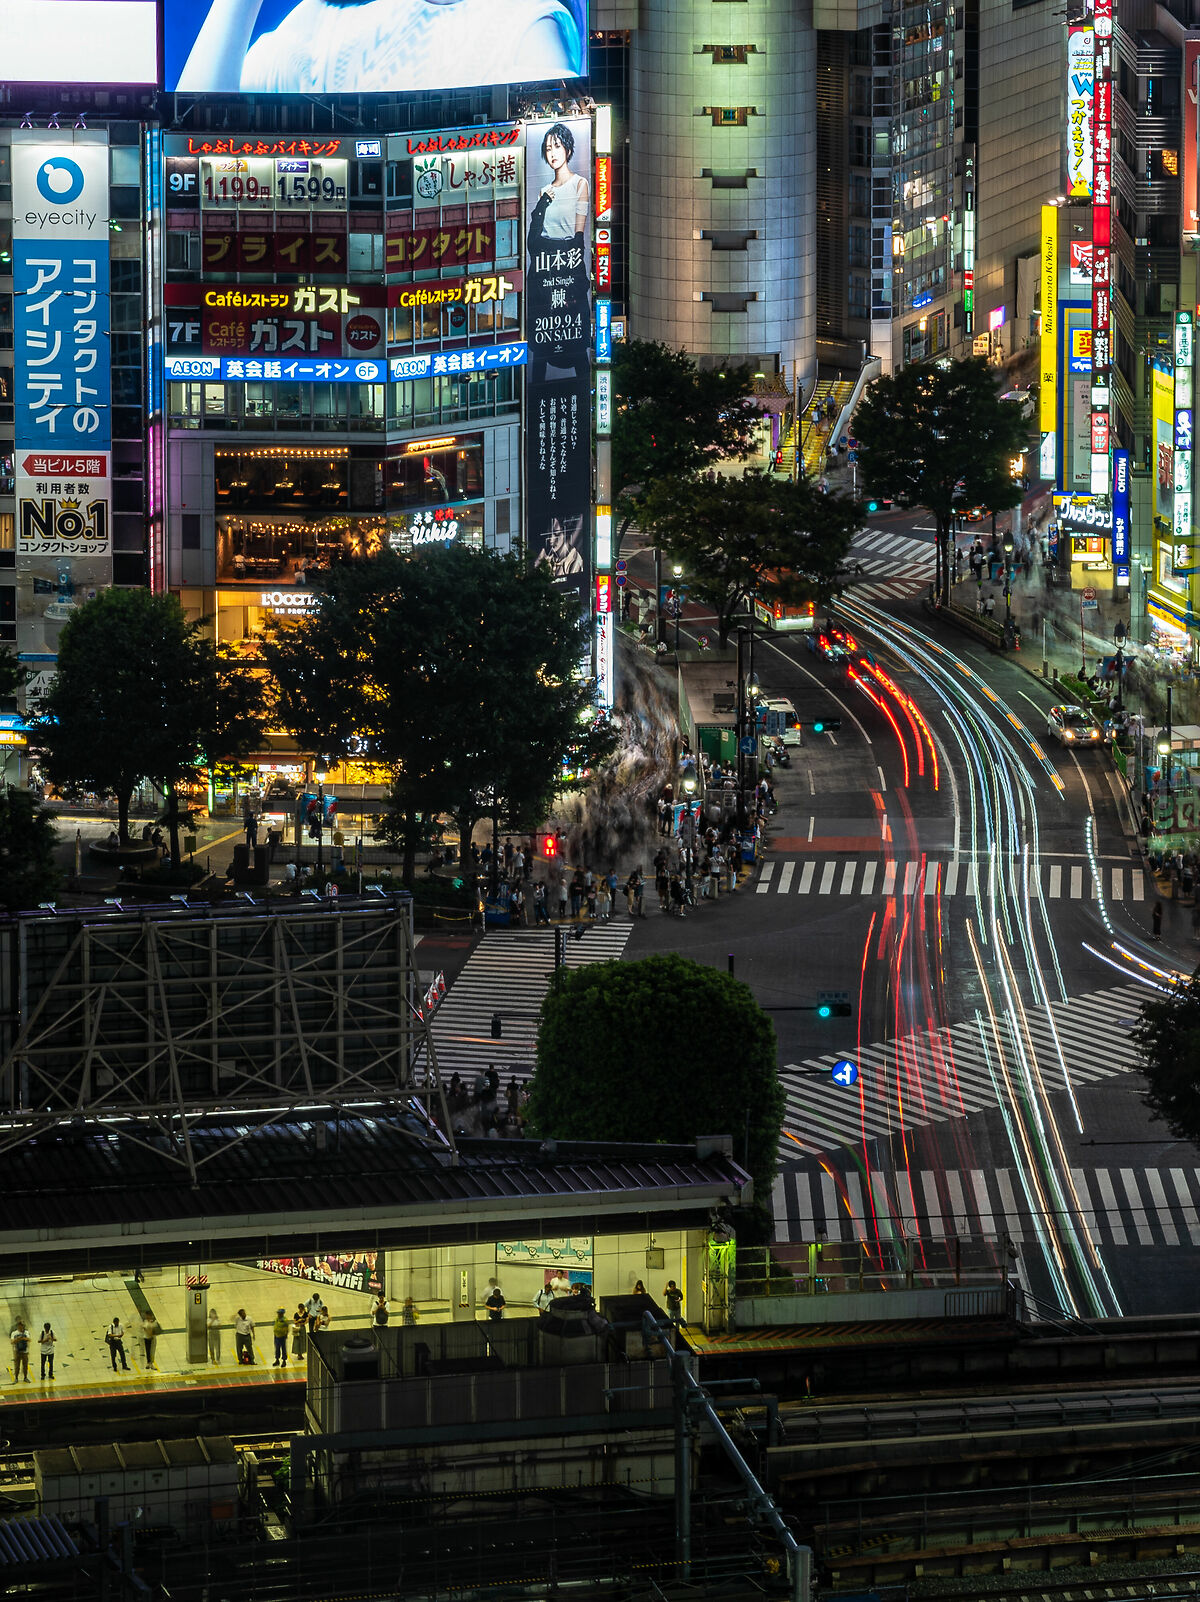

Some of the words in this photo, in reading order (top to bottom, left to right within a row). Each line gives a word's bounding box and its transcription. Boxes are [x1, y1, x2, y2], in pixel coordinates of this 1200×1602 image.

[188, 138, 341, 157] しゃぶしゃぶバイキング
[407, 128, 521, 155] しゃぶしゃぶバイキング
[279, 161, 308, 170] ディナー
[449, 154, 516, 189] しゃぶ葉
[169, 173, 197, 192] 9F
[204, 176, 270, 206] 1,199円
[277, 176, 347, 206] 1,599円
[24, 209, 97, 230] eyecity
[205, 236, 342, 263] プライス
[386, 228, 491, 263] コンタクト
[535, 248, 583, 272] 山本彩
[599, 255, 609, 286] ガスト
[463, 275, 514, 305] ガスト
[542, 277, 555, 288] 2nd
[556, 275, 575, 287] Single
[205, 290, 289, 308] Caféレストラン
[293, 286, 360, 314] ガスト
[400, 287, 462, 307] Caféレストラン
[551, 288, 567, 309] 棘
[1045, 275, 1053, 334] Matsumoto
[168, 322, 200, 342] 7F
[208, 322, 246, 337] Café
[535, 313, 583, 332] 2019.9.4
[209, 338, 245, 348] レストラン
[250, 318, 333, 352] ガスト
[350, 330, 378, 342] ガスト
[535, 330, 552, 344] ON
[554, 327, 583, 342] SALE
[25, 258, 63, 434] アイシティ
[72, 258, 100, 434] コンタクトの
[172, 361, 214, 376] AEON
[226, 360, 350, 379] 英会話イーオン
[358, 365, 376, 377] 6F
[395, 362, 427, 377] AEON
[433, 347, 526, 374] 英会話イーオン
[599, 376, 609, 429] 渋谷駅前ビル
[33, 458, 101, 474] 当ビル5階
[1116, 457, 1126, 493] MIZUHO
[36, 482, 90, 495] 利用者数
[20, 498, 108, 540] No.1
[413, 511, 433, 525] 渋谷
[1061, 497, 1113, 529] グルメタウン
[19, 541, 109, 553] コンタクトショップ
[1115, 517, 1125, 556] みずほ銀行
